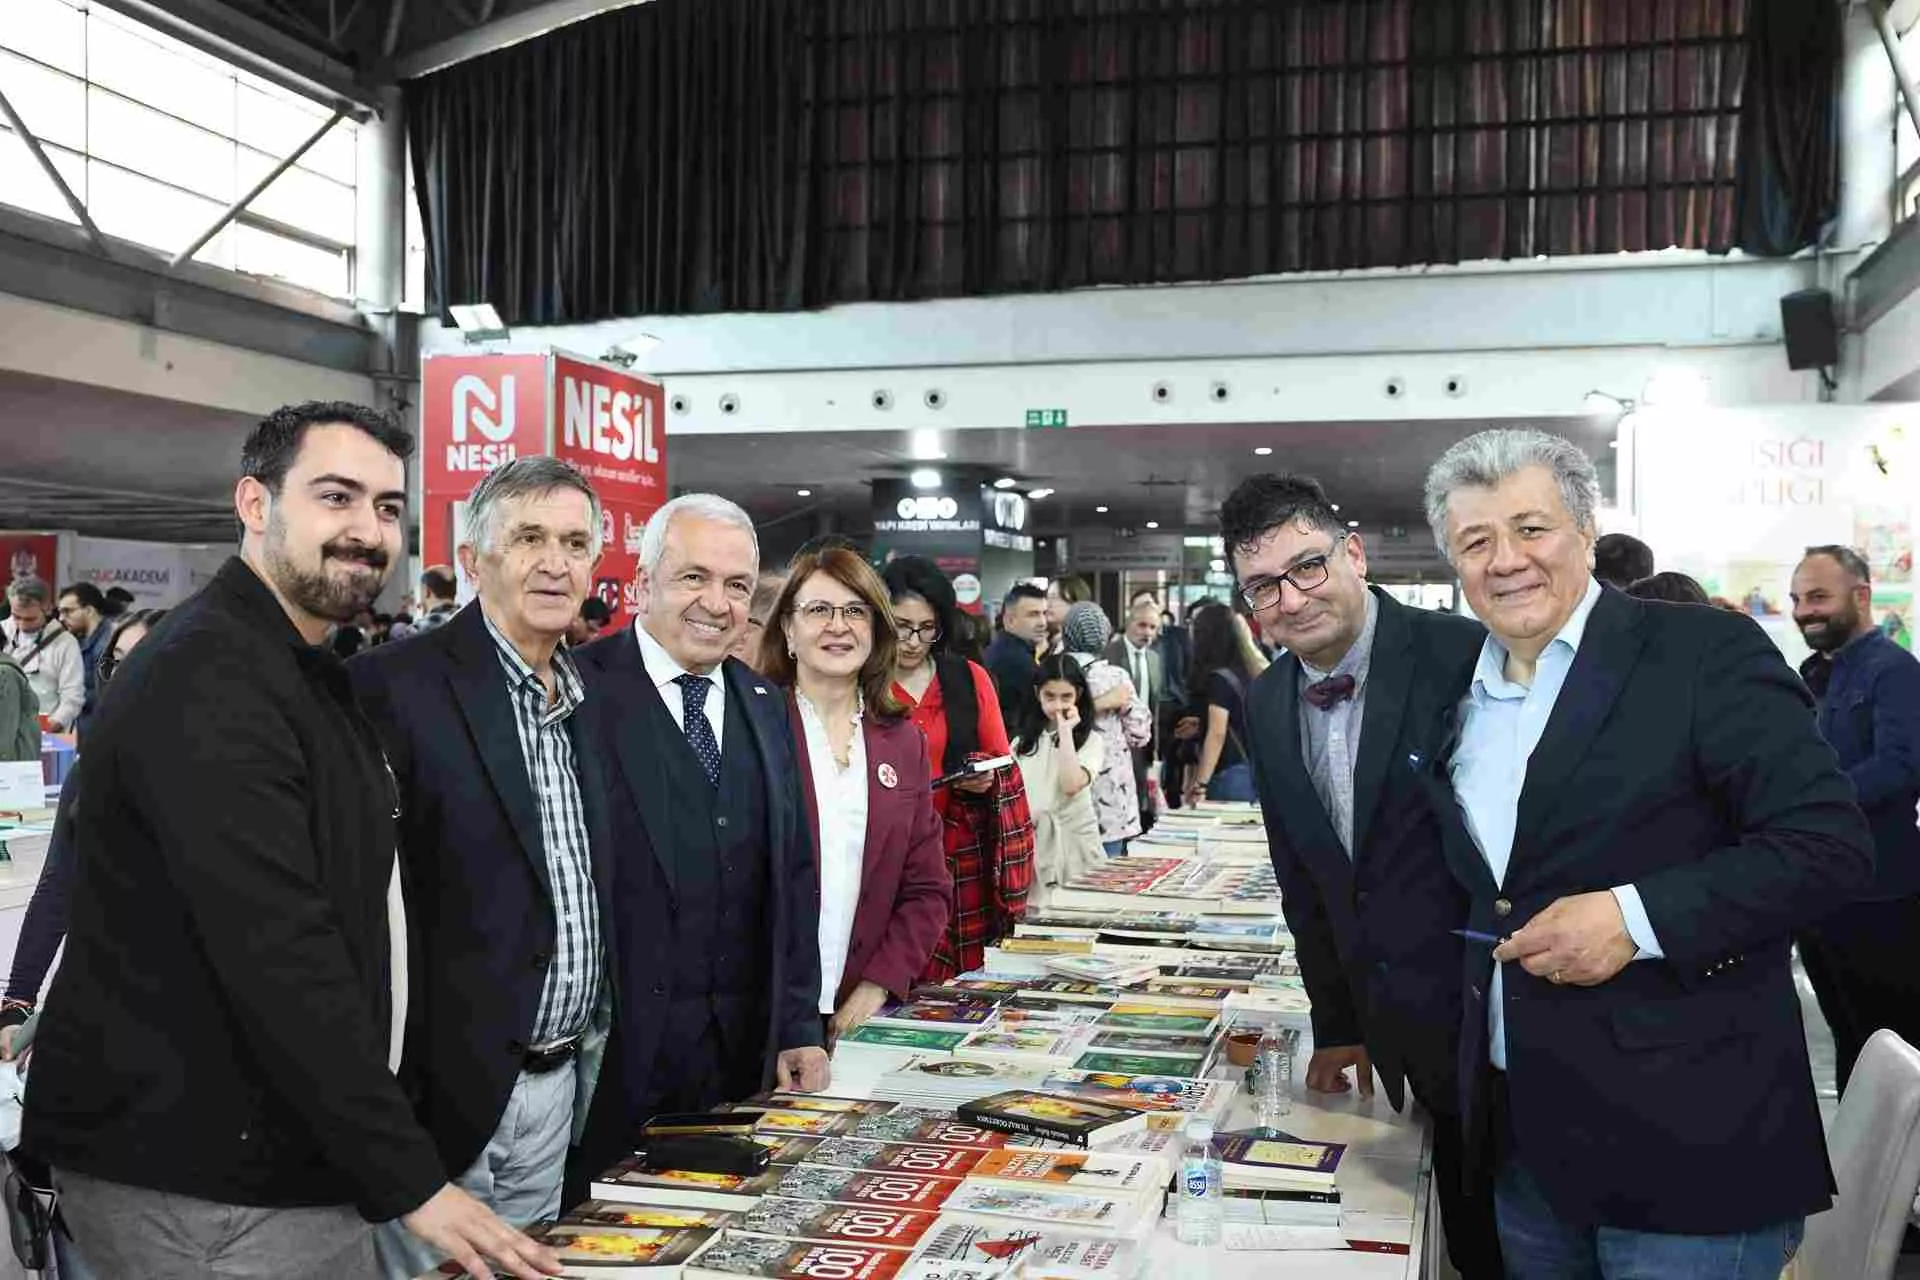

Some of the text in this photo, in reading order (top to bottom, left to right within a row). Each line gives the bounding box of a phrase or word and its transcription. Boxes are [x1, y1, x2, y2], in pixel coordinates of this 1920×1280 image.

[901, 1148, 951, 1170] 100
[869, 1178, 923, 1202] 100
[841, 1210, 899, 1238] 100
[807, 1247, 870, 1280] 100
